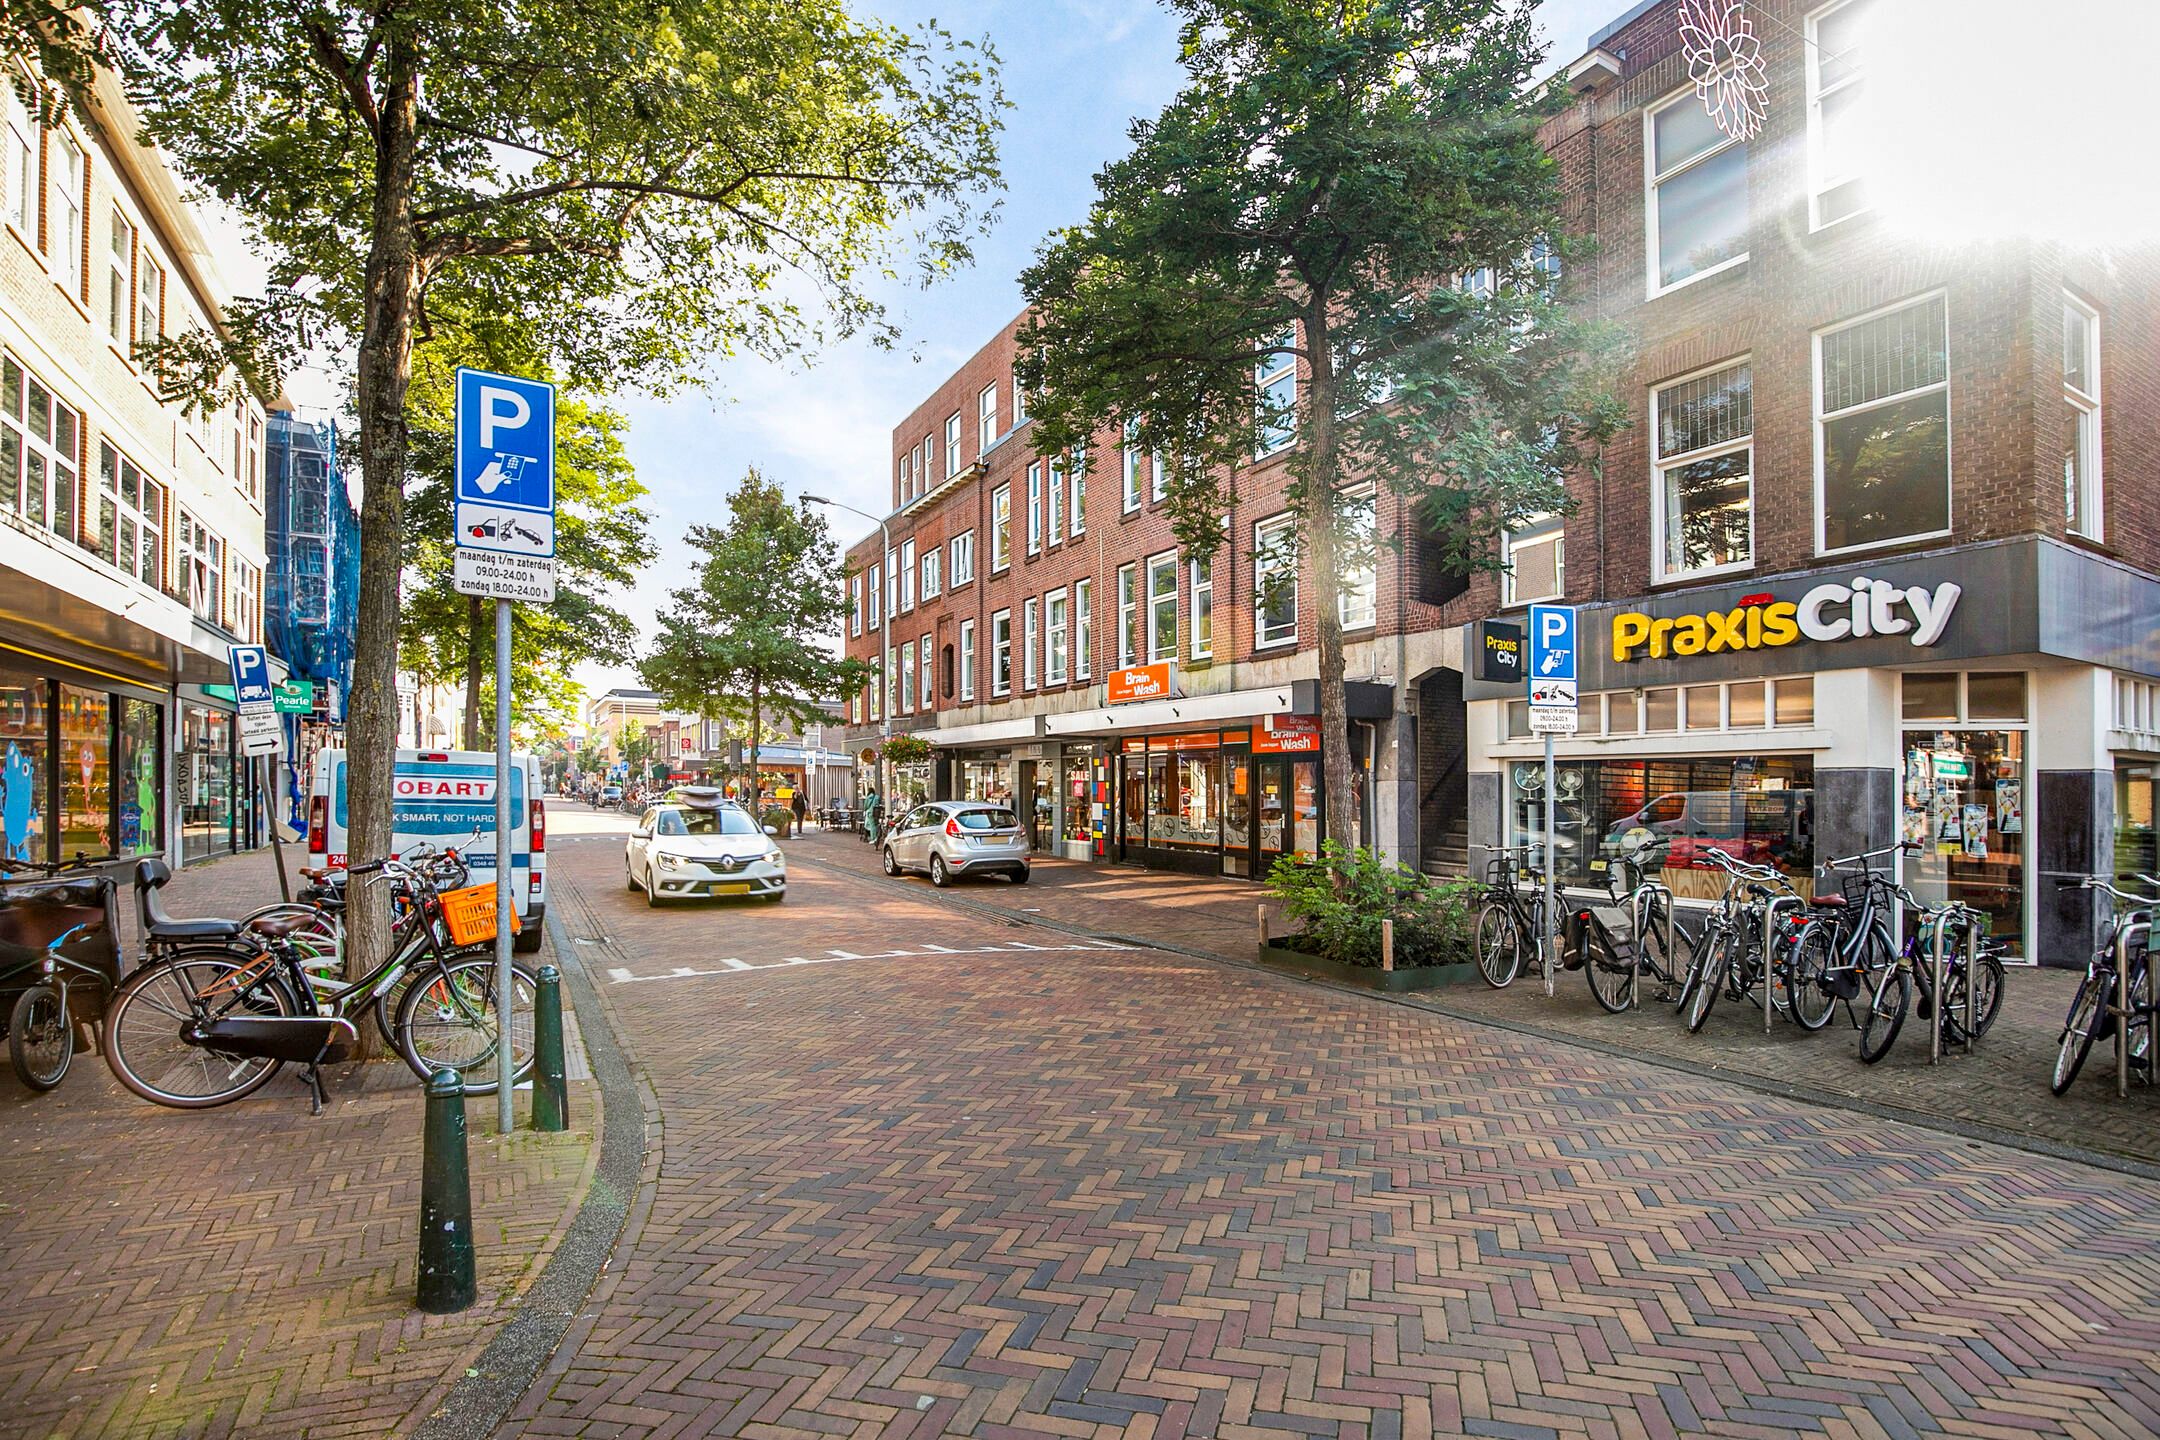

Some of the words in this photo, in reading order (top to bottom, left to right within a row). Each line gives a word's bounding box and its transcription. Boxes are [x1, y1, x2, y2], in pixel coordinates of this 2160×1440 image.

[480, 385, 531, 449] P
[459, 551, 496, 567] maandag
[498, 554, 514, 566] t/m
[516, 556, 551, 573] zaterdag
[475, 566, 528, 583] 09.00-24.00
[529, 573, 535, 583] h
[461, 580, 490, 594] zondag
[492, 582, 541, 597] 18.00-24.00
[543, 588, 549, 598] h
[1542, 612, 1567, 649] P
[1486, 635, 1518, 652] Praxis
[236, 649, 261, 679] P
[1496, 650, 1518, 668] City
[1125, 671, 1150, 685] Brain
[1133, 680, 1160, 696] Wash
[275, 695, 310, 706] Pearle
[1289, 716, 1308, 724] Brain
[1280, 736, 1311, 750] Wash
[1070, 770, 1090, 781] SALE
[397, 780, 489, 796] OBART
[402, 813, 441, 823] SMART,
[443, 814, 465, 822] NOT
